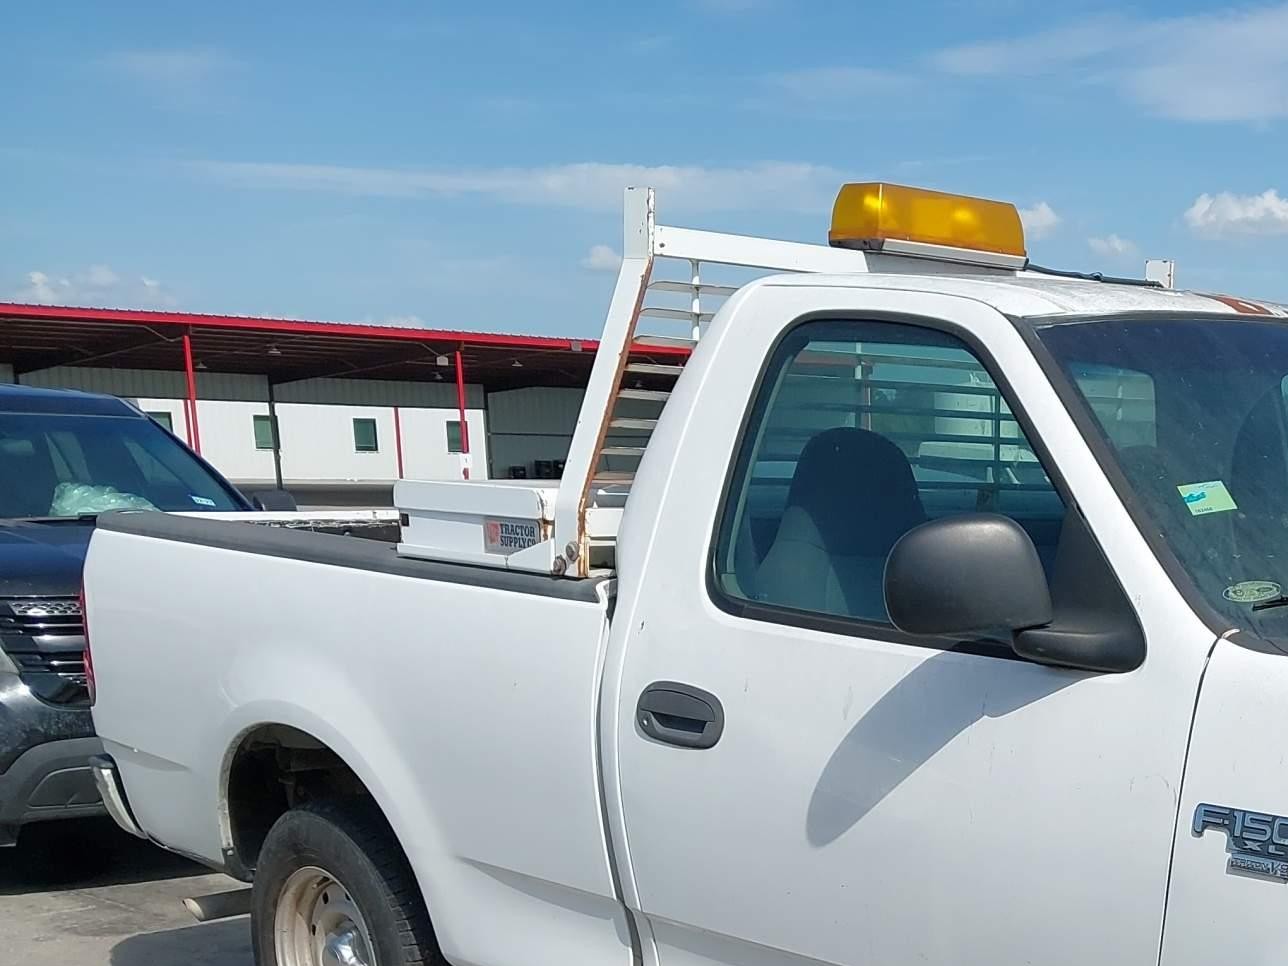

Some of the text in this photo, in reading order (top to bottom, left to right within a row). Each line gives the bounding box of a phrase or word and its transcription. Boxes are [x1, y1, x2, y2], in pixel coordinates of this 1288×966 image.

[500, 523, 536, 538] TRACTOR
[500, 536, 526, 549] SUPPLY
[1243, 840, 1285, 856] XL
